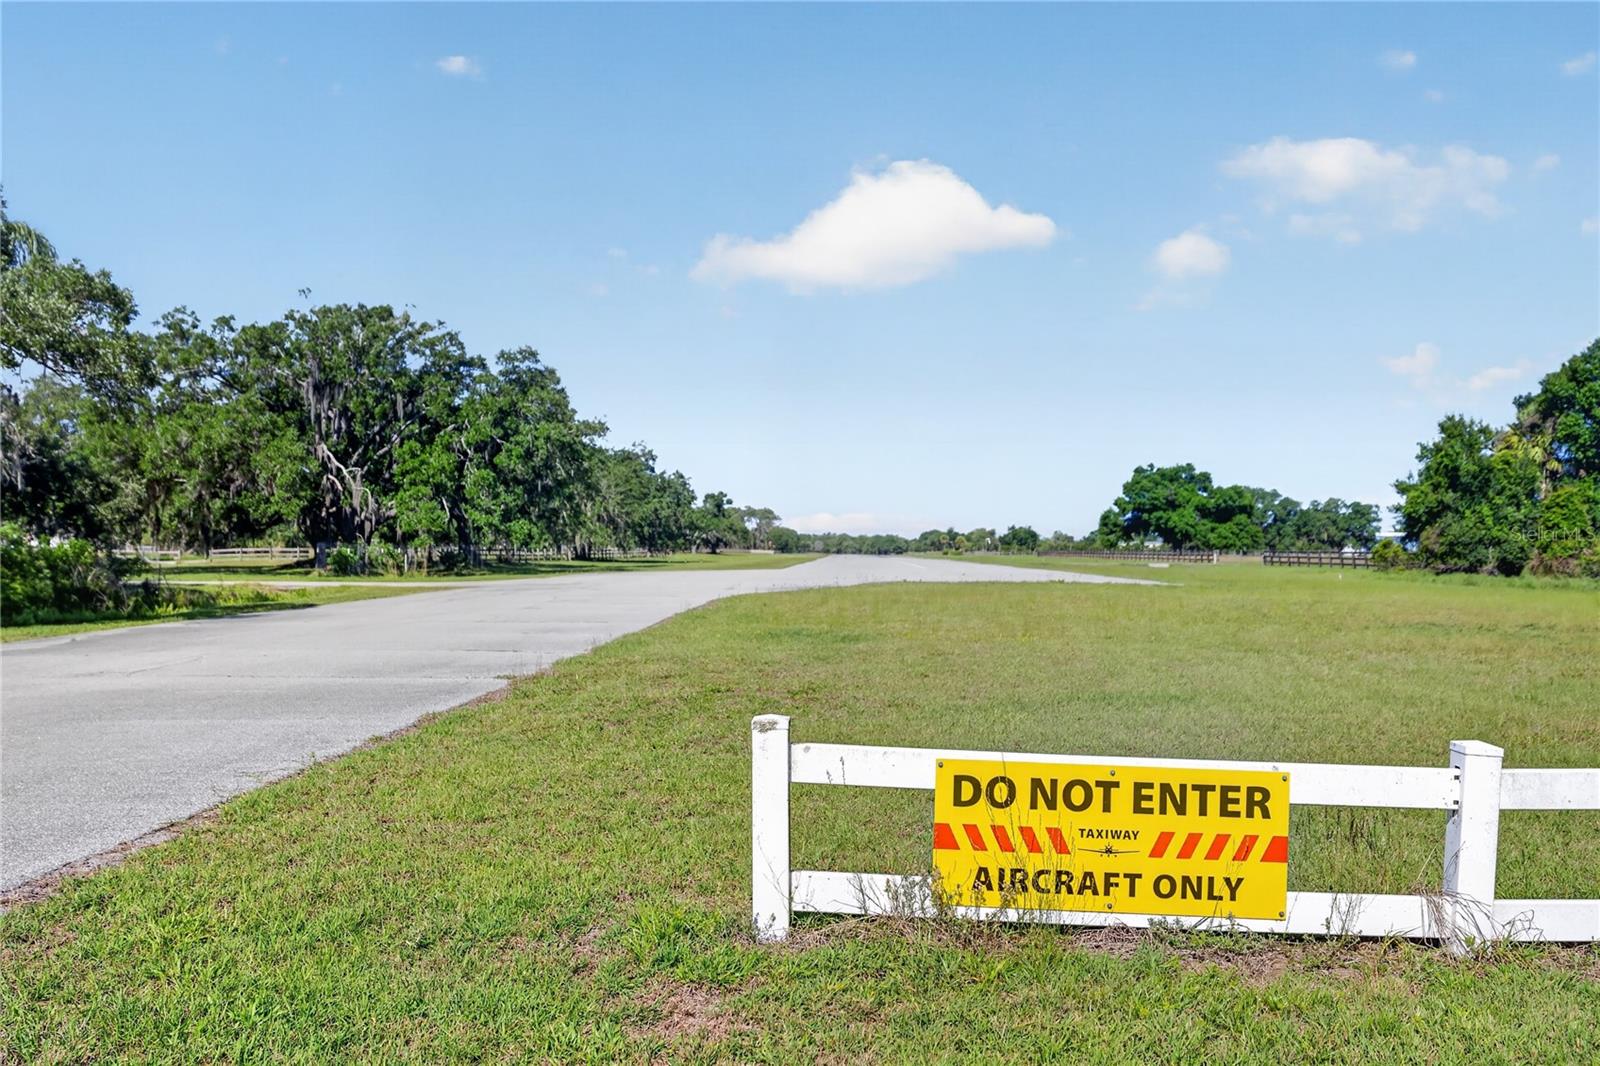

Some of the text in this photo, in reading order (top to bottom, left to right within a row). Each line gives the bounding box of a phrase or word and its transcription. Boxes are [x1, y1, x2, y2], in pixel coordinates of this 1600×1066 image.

[952, 774, 1272, 820] DO NOT ENTER
[1078, 828, 1140, 841] TAXIWAY
[972, 866, 1245, 902] AIRCRAFT ONLY
